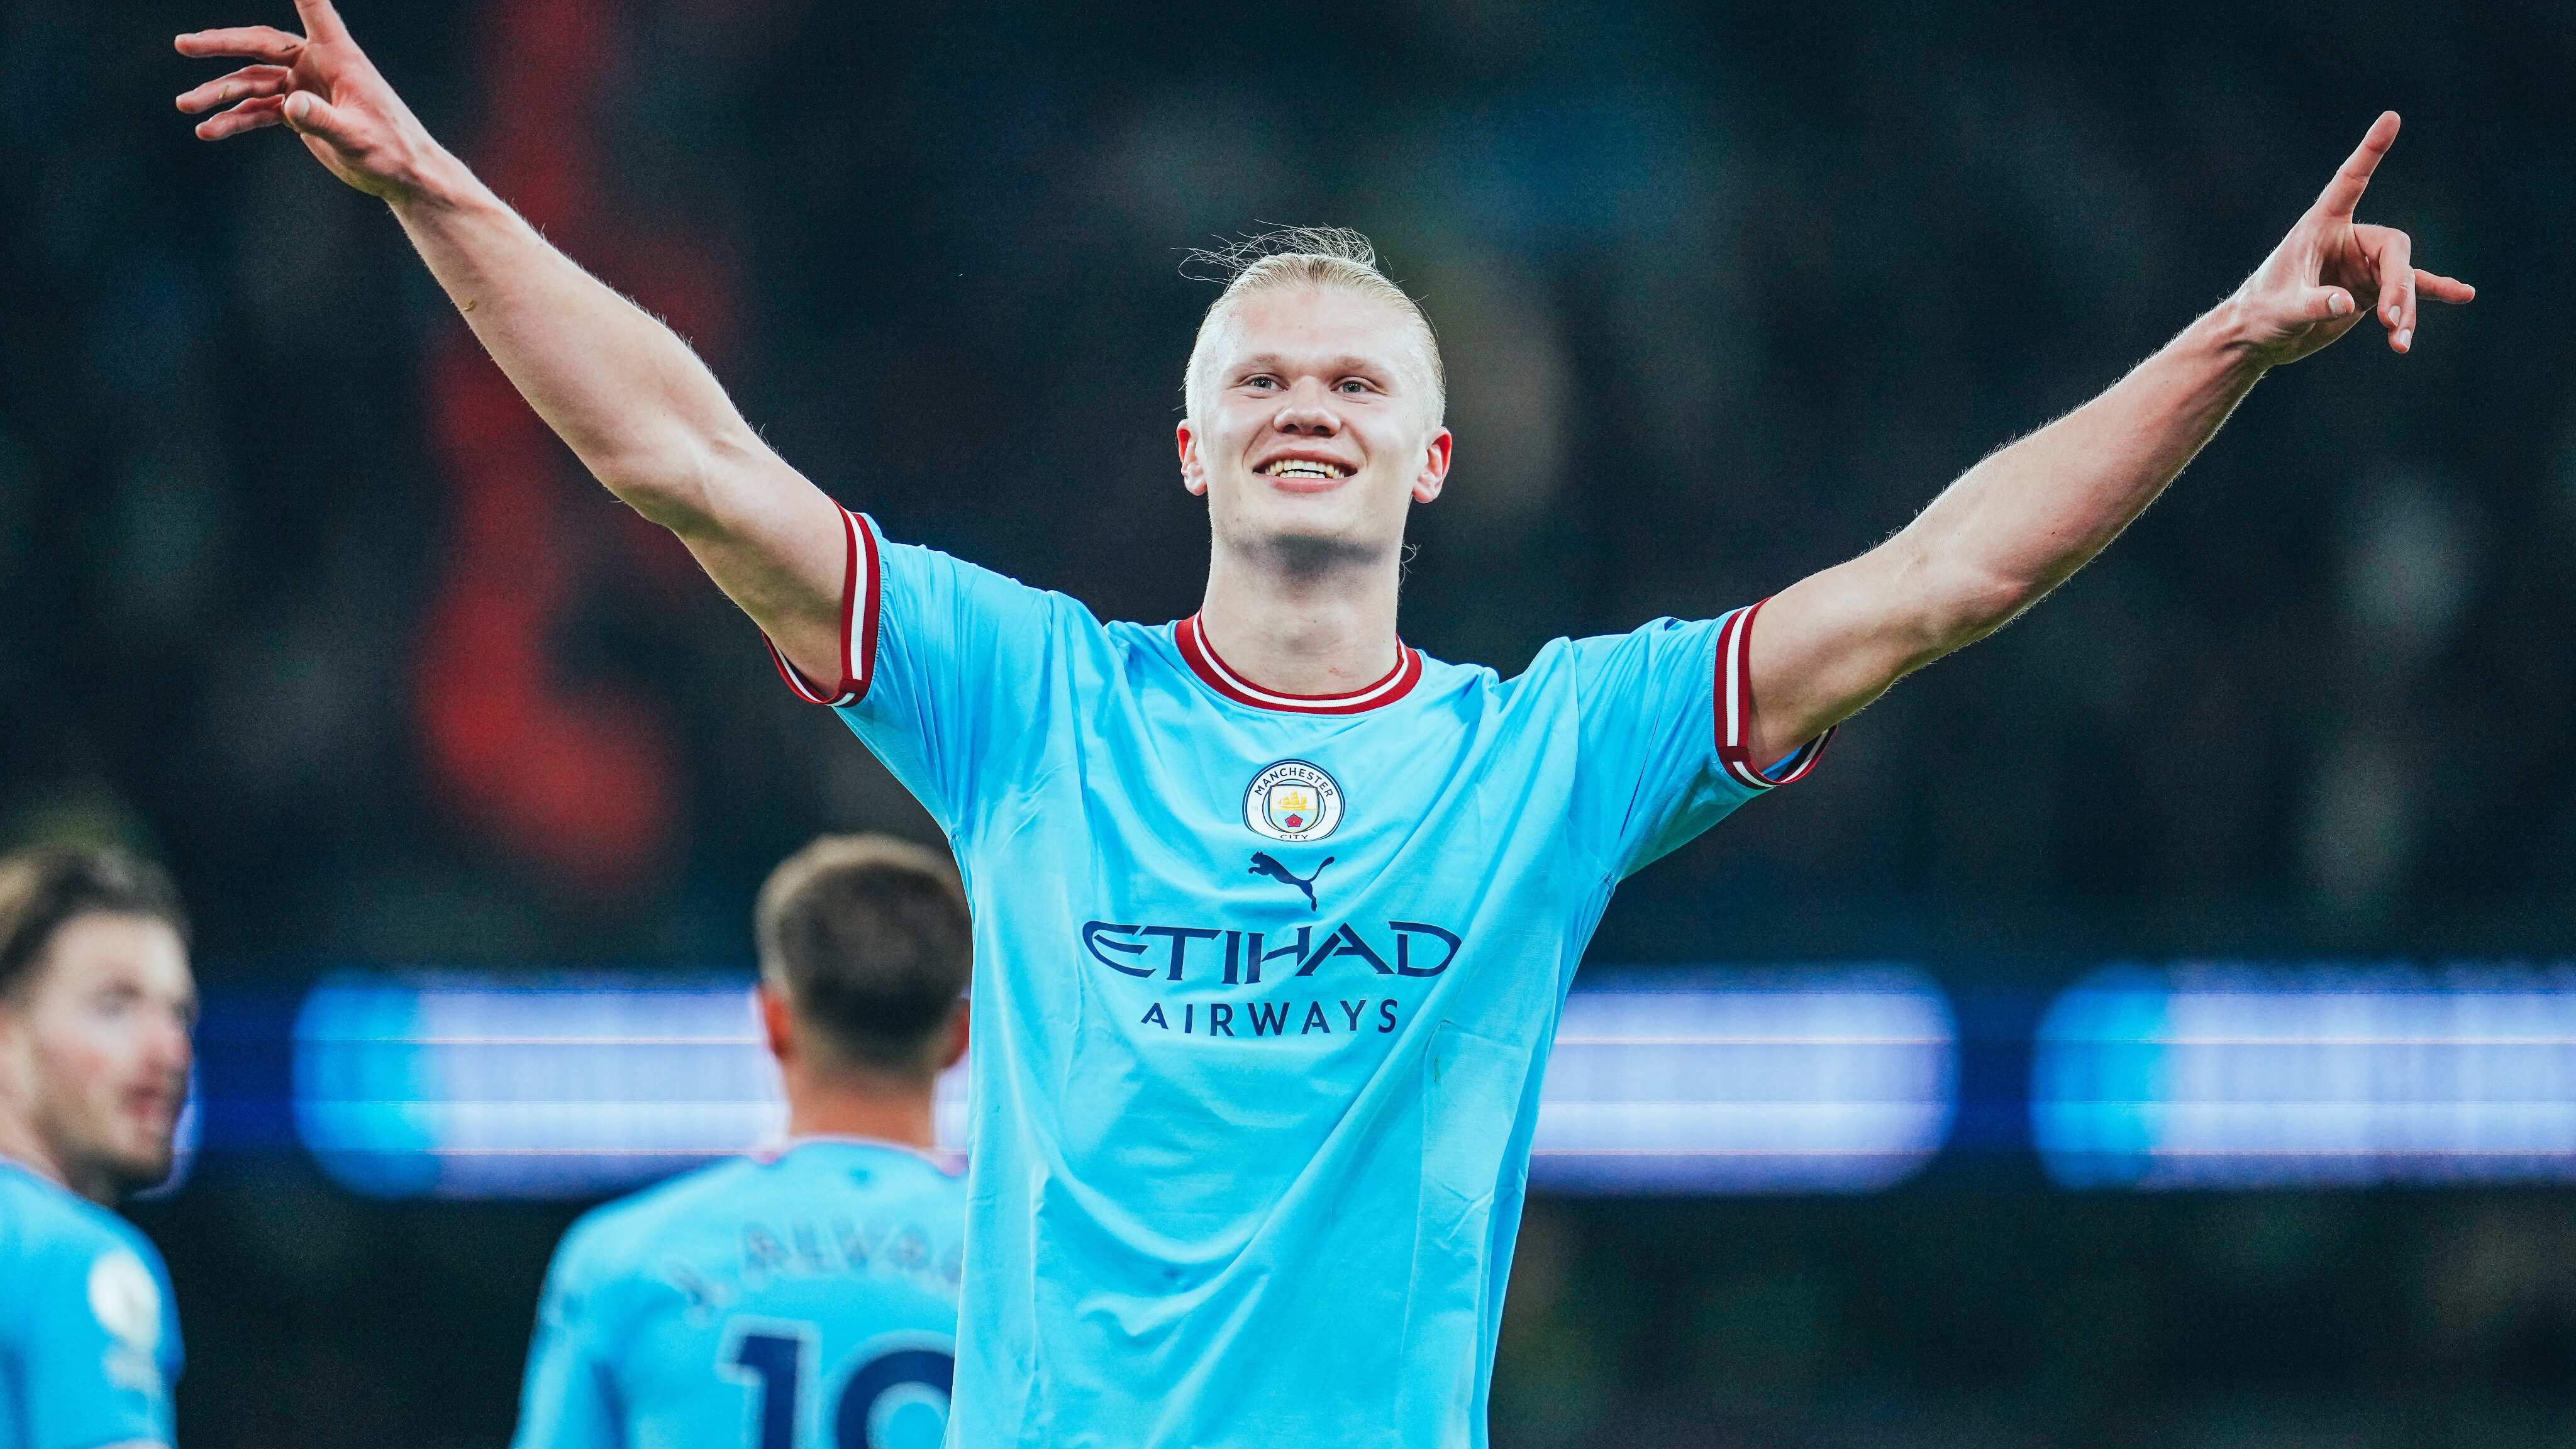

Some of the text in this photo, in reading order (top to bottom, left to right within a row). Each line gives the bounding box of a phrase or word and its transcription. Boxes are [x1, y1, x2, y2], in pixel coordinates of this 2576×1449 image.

[1255, 767, 1333, 797] MANCHESTER
[1082, 920, 1462, 984] ETIHAD
[1140, 999, 1398, 1036] AIRWAYS
